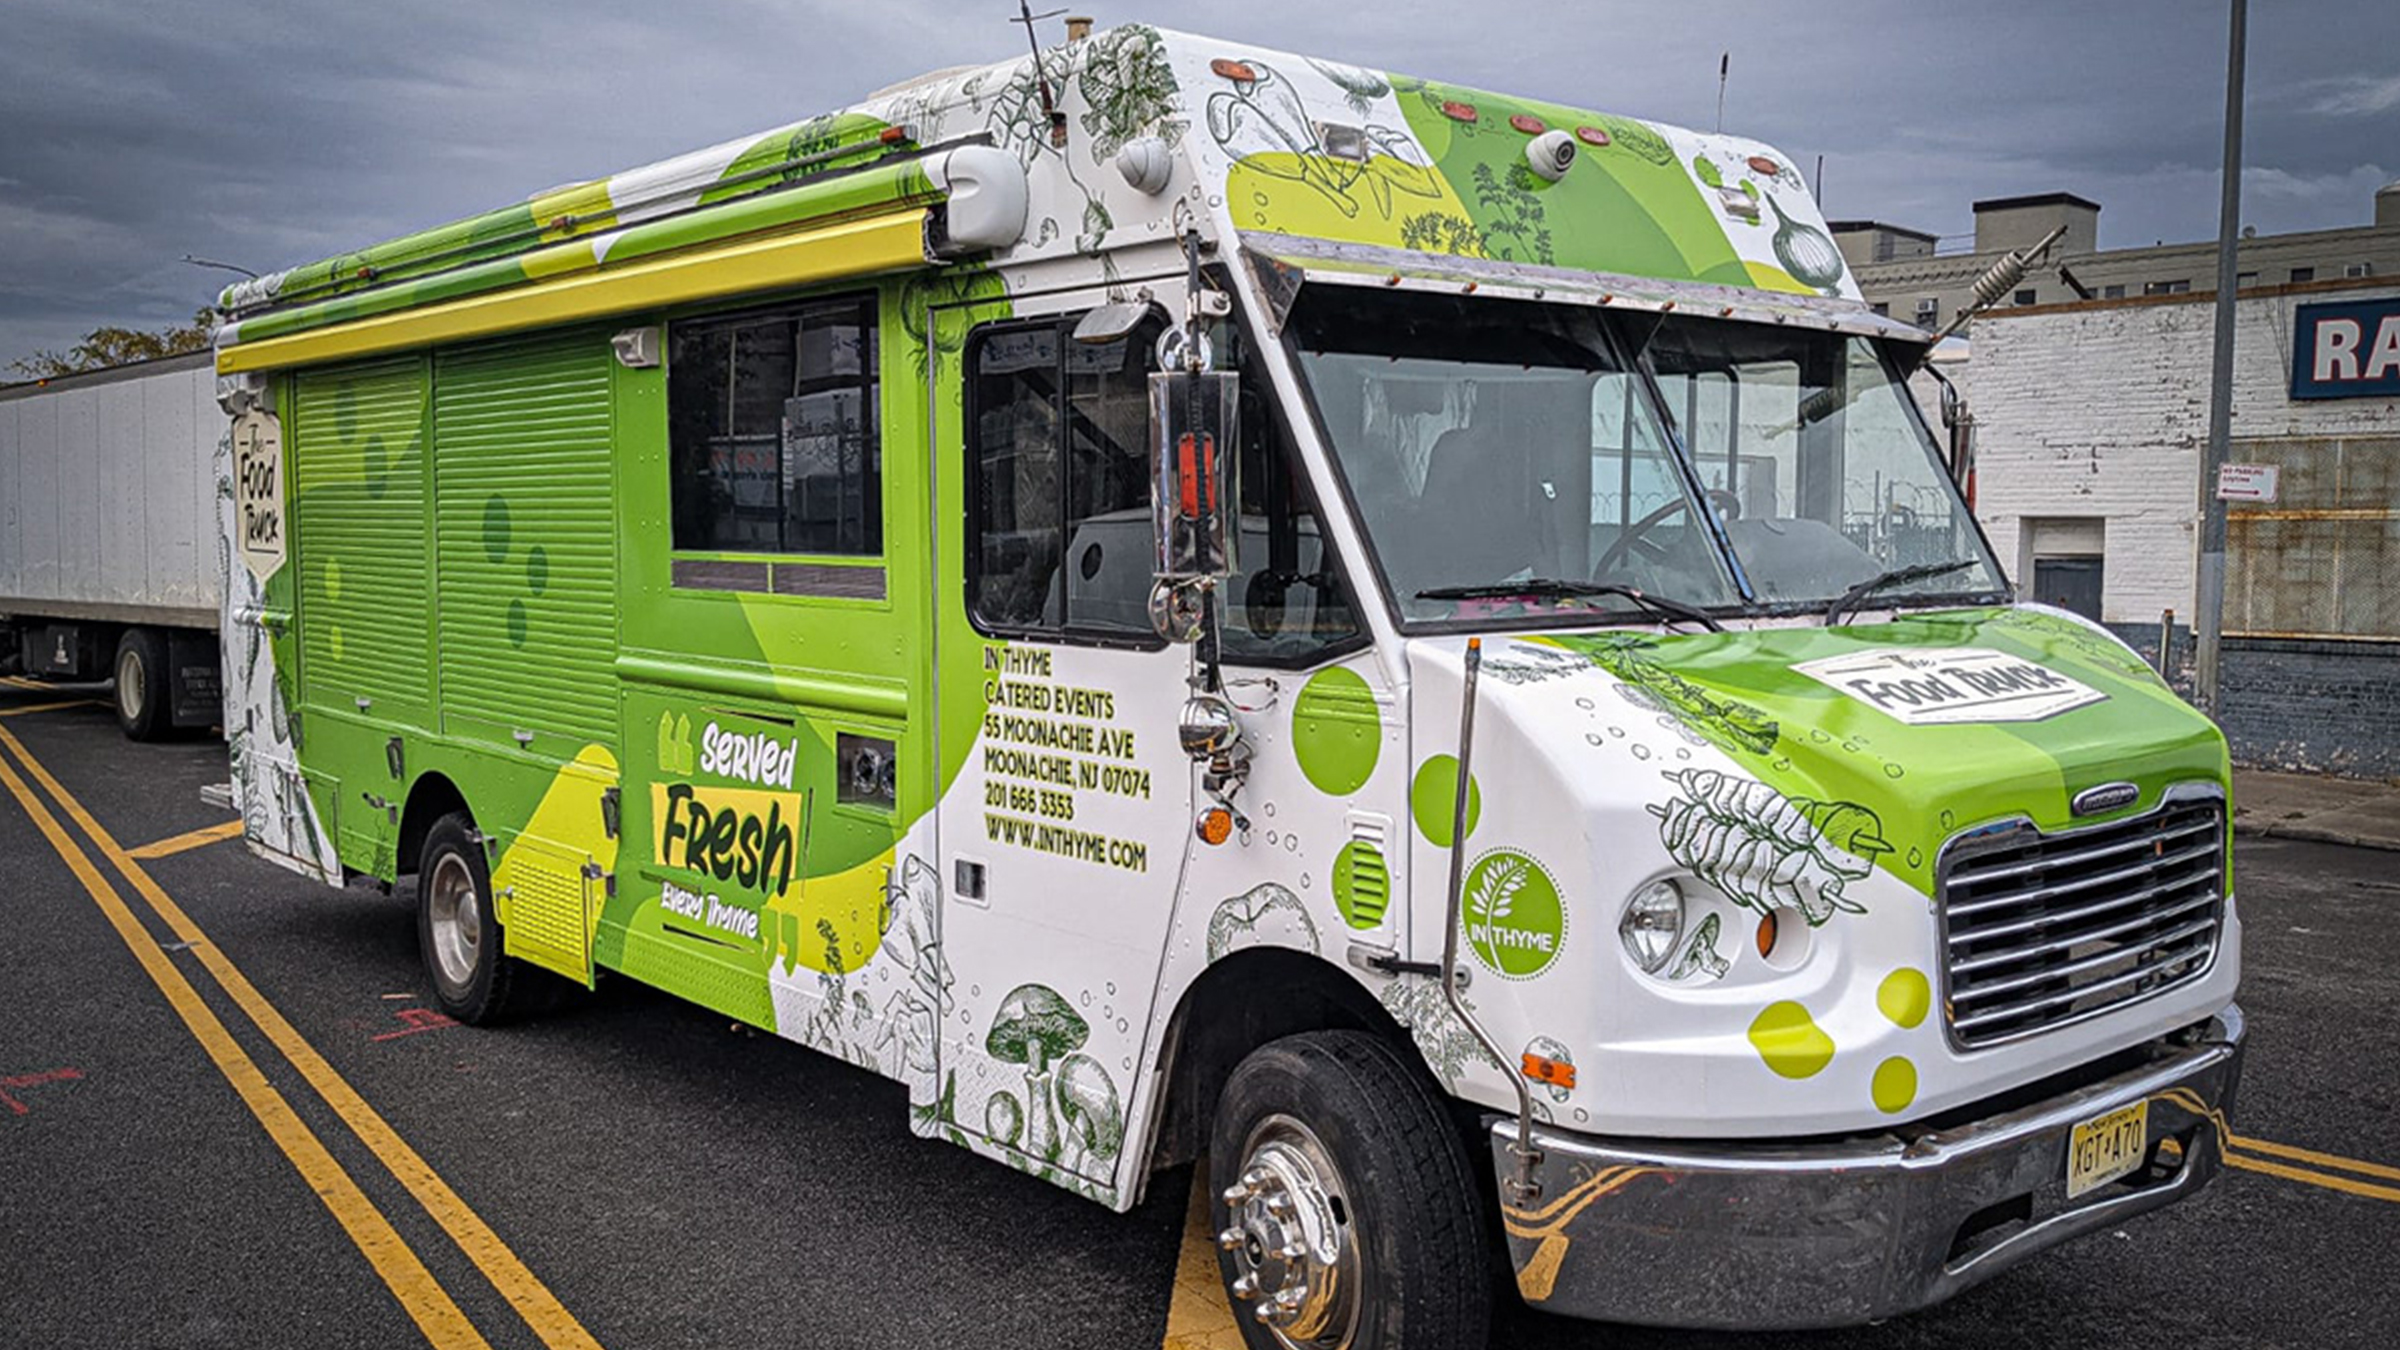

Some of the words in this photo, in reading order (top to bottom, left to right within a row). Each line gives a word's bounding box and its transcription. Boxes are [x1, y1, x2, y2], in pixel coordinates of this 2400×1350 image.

[241, 453, 276, 500] Food
[984, 646, 999, 670] IN
[1003, 648, 1052, 676] THYME
[984, 680, 1050, 712] CATERED
[1055, 687, 1114, 720] EVENTS
[1846, 671, 1969, 710] Food
[984, 714, 1000, 739] 55
[1003, 715, 1093, 753] MOONACHIE
[1098, 729, 1135, 760] AVE
[984, 747, 1077, 790] MOONACHIE,
[1079, 761, 1099, 790] NJ
[1102, 765, 1151, 800] 07074
[985, 780, 1007, 808] 201
[1010, 785, 1037, 813] 666
[1039, 789, 1075, 821] 3353
